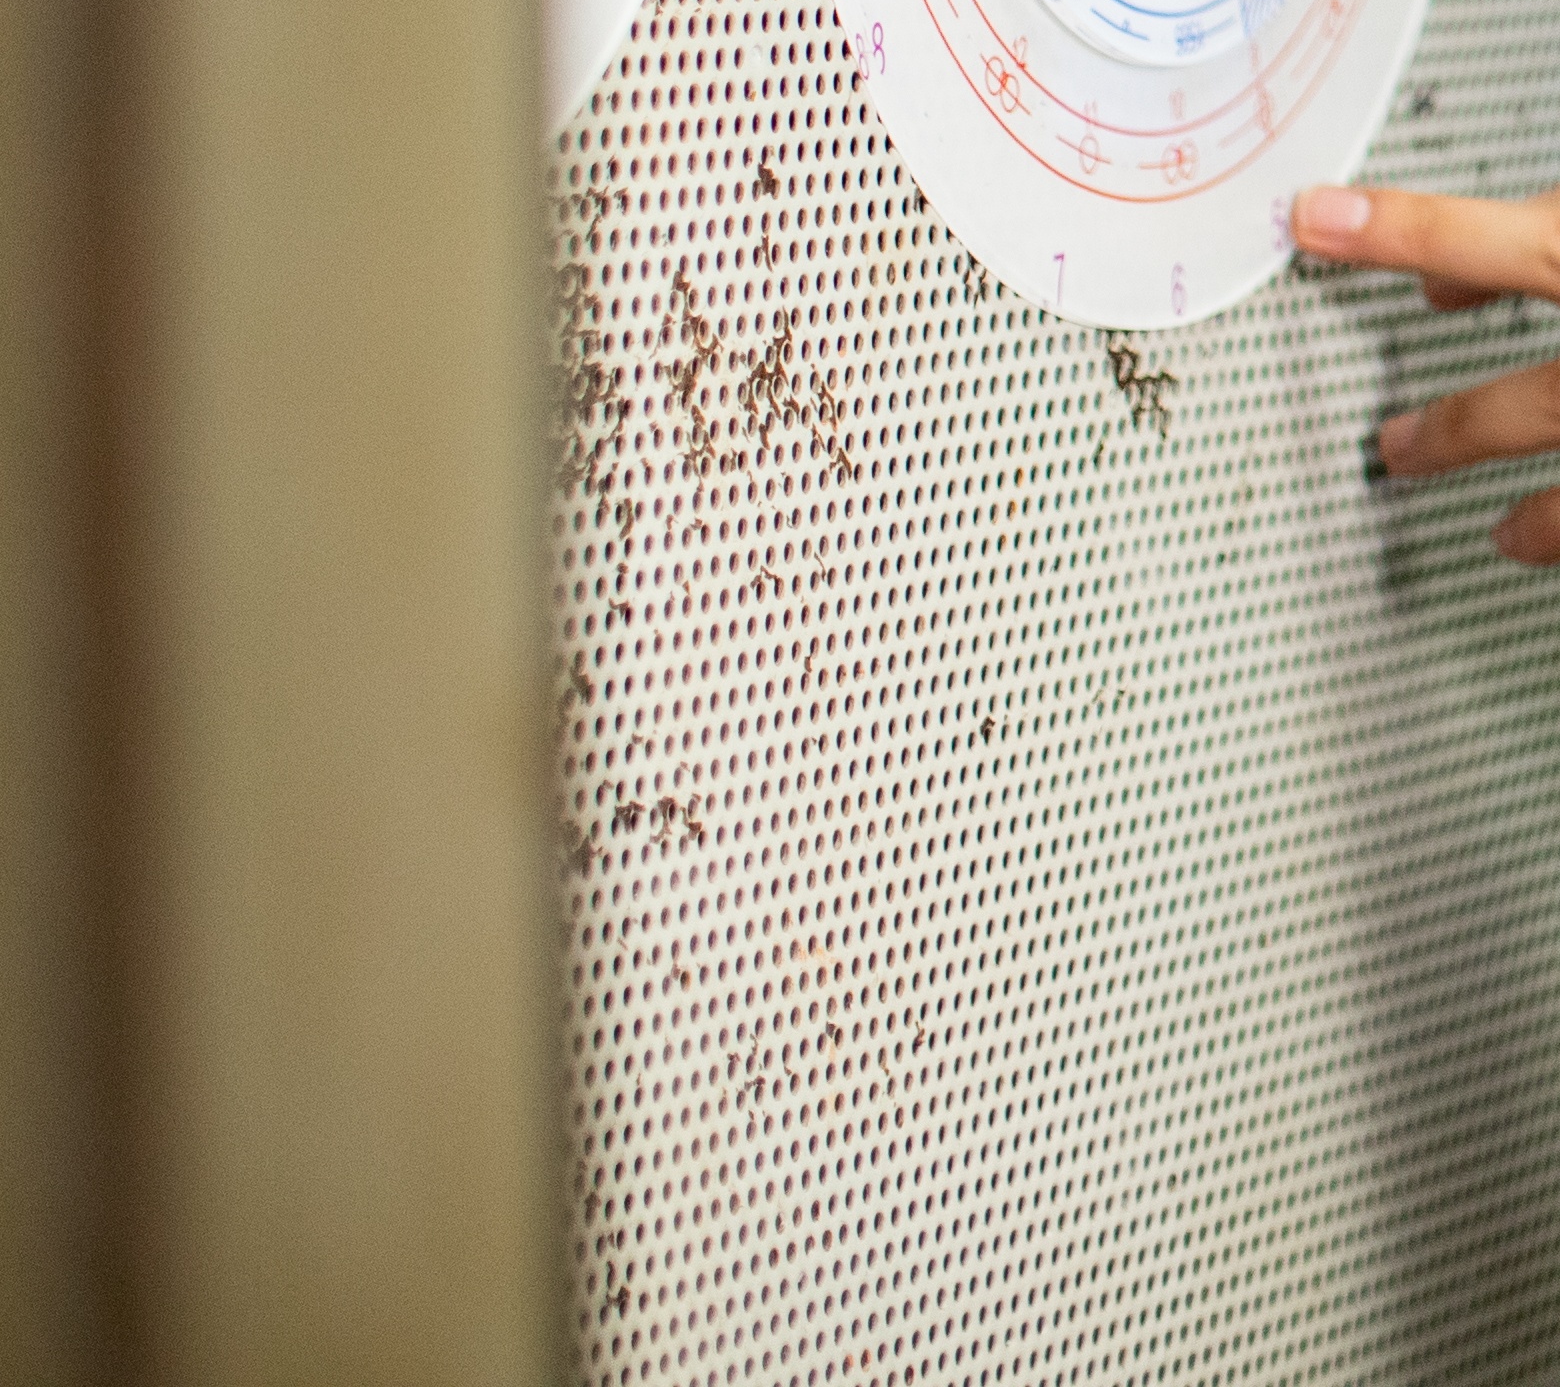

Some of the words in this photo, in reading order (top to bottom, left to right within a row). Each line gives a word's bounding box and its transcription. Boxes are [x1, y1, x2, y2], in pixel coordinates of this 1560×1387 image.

[872, 22, 886, 76] 8
[1053, 251, 1065, 306] 7
[1171, 261, 1187, 316] 6
